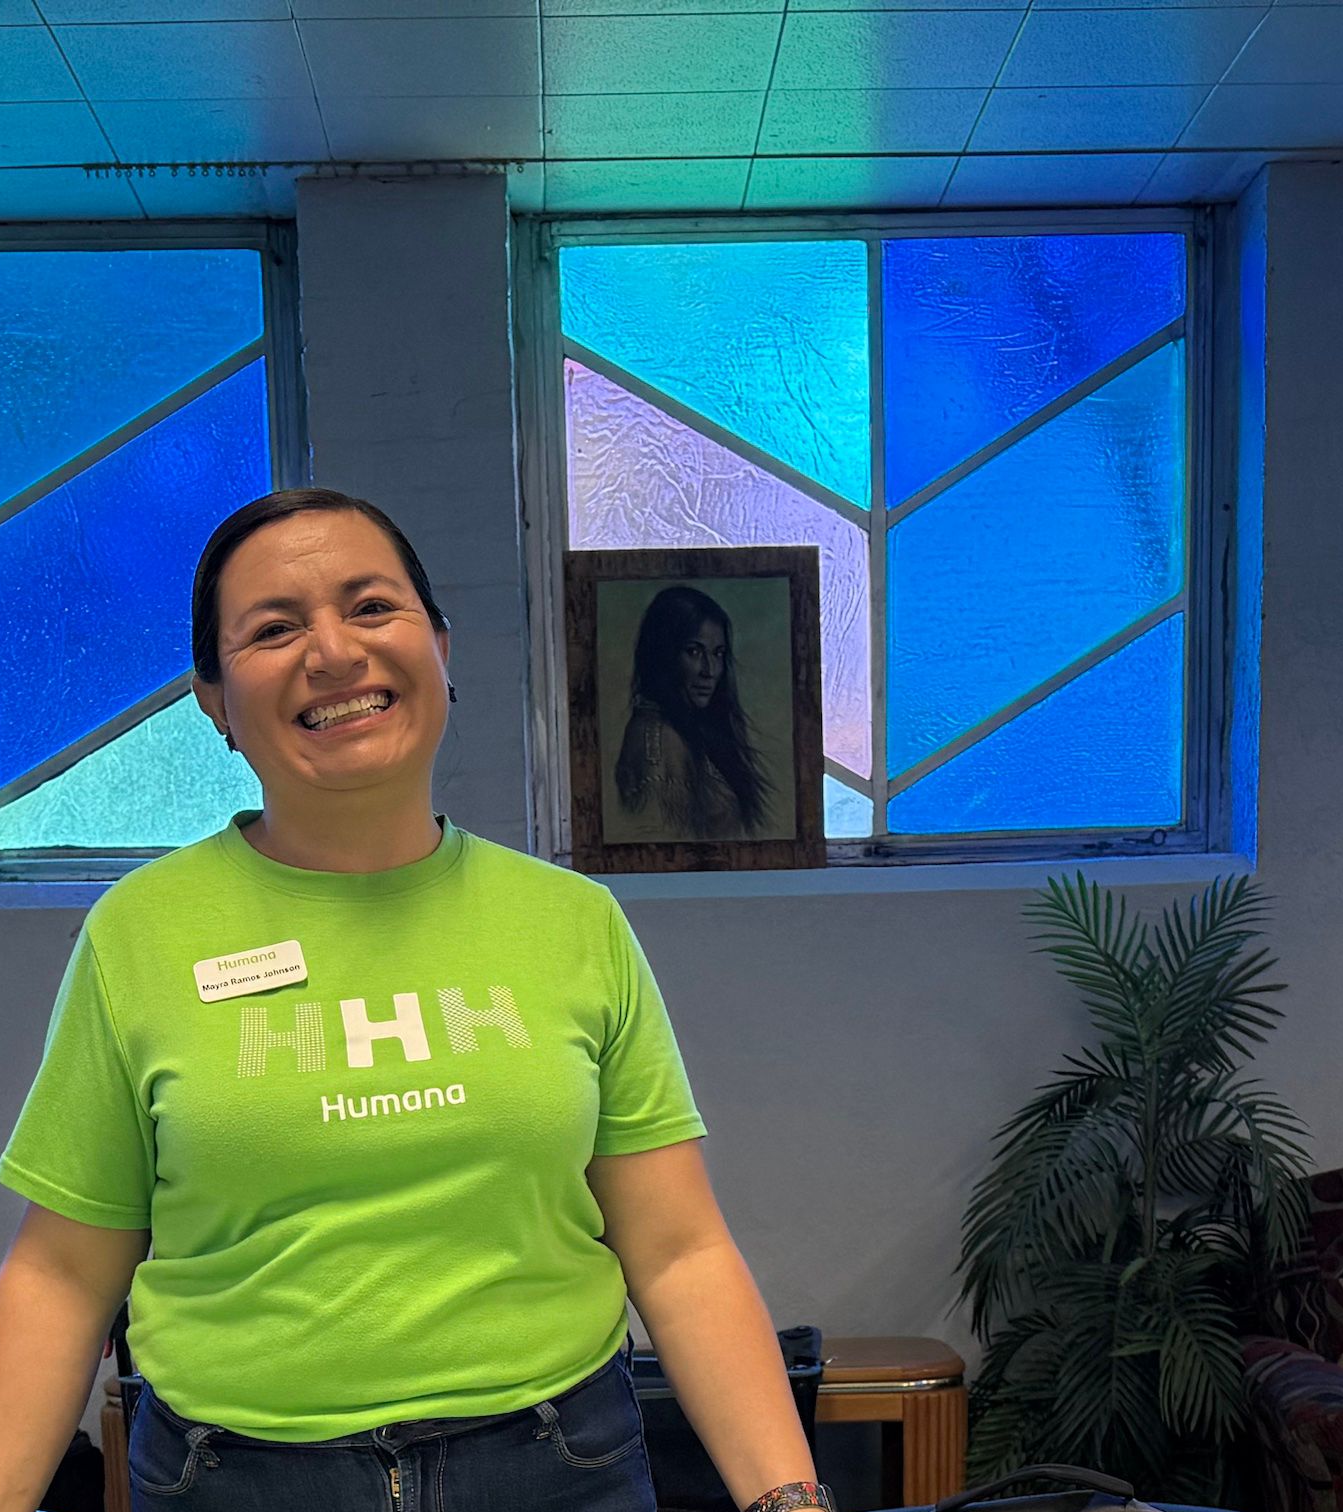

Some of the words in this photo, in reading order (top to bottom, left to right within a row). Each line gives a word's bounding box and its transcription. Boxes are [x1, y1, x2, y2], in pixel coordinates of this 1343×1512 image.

[217, 950, 276, 971] Humana
[202, 979, 229, 992] Mayra
[230, 973, 261, 986] Ramos
[263, 964, 301, 979] Johnson
[320, 1083, 466, 1123] Humana
